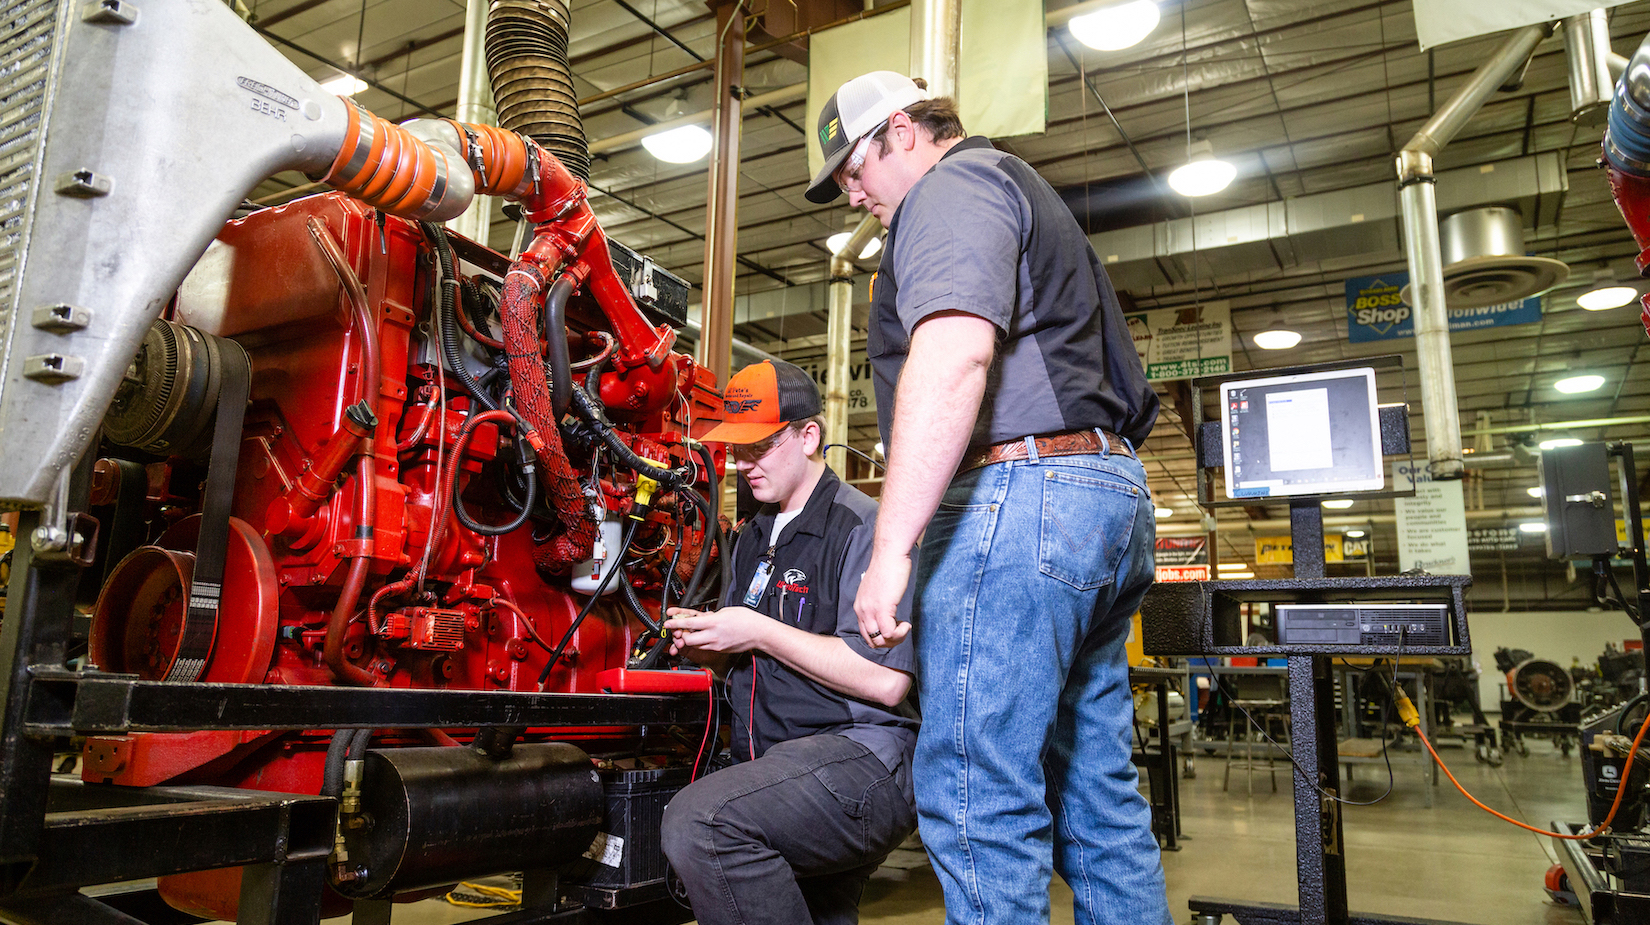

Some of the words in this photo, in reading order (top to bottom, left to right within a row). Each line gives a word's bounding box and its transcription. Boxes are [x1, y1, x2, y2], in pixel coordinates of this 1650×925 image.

[250, 97, 286, 122] BEHR
[1355, 292, 1401, 309] BOSS
[1356, 307, 1410, 325] Shop
[1398, 465, 1422, 475] Our
[1344, 540, 1369, 556] CAT
